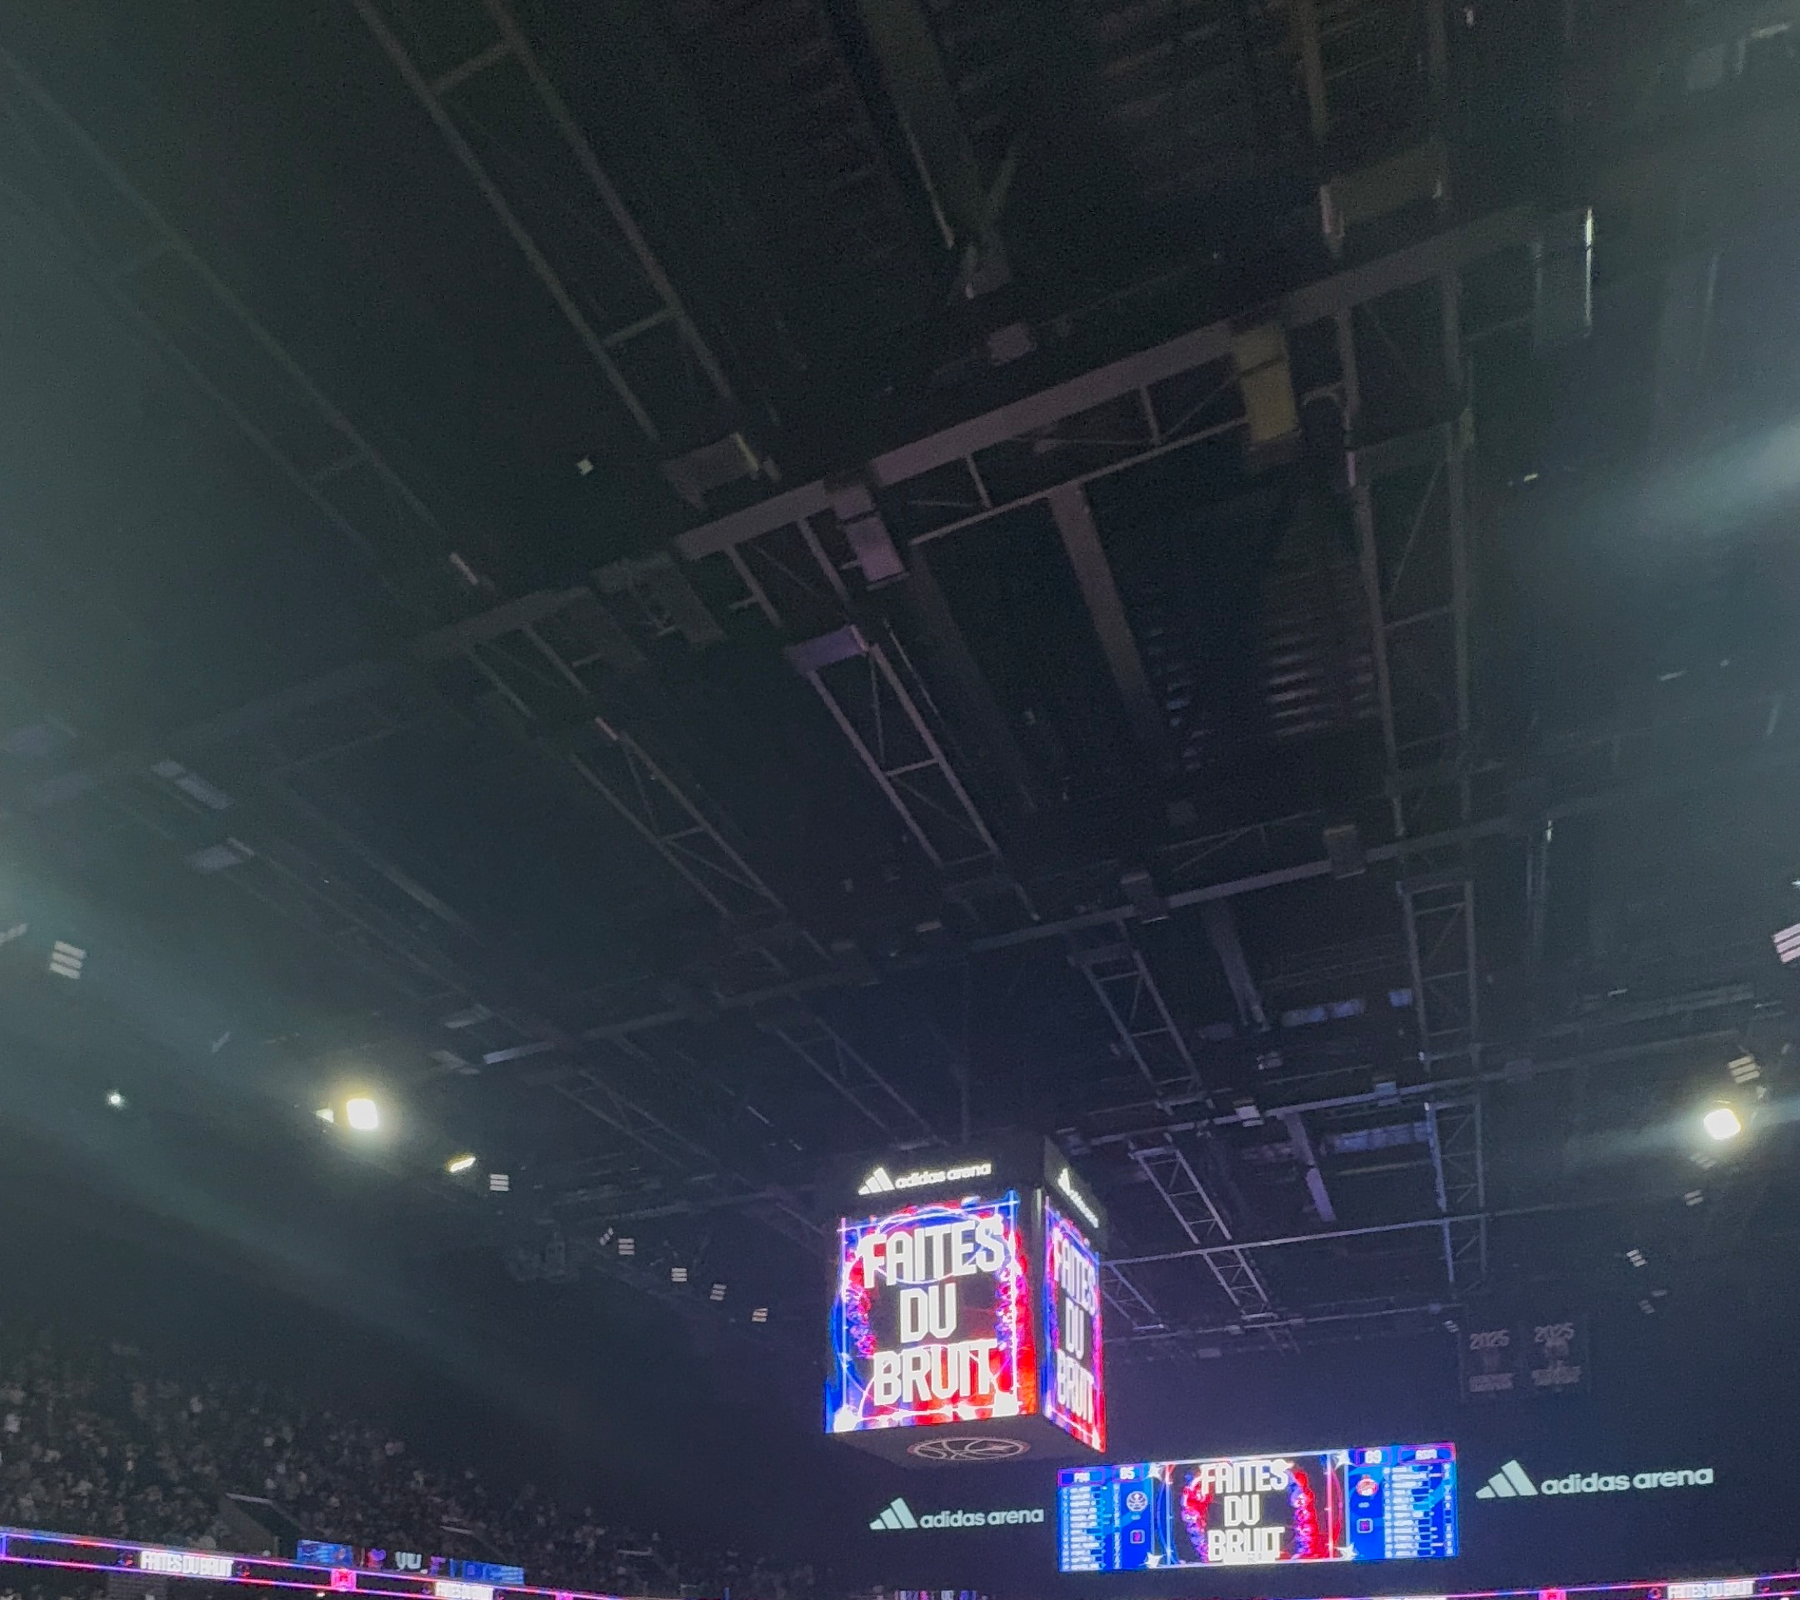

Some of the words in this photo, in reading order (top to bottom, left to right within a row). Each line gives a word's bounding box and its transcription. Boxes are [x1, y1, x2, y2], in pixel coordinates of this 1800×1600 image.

[895, 1170, 946, 1189] adidas
[947, 1163, 992, 1180] arena
[858, 1215, 1005, 1289] FAITES
[1052, 1226, 1097, 1316] FAITES
[900, 1282, 957, 1343] DU
[1065, 1297, 1085, 1360] DU
[872, 1338, 999, 1405] BRUIT
[1056, 1347, 1095, 1424] BRUIT
[1200, 1459, 1289, 1498] FAITES
[1541, 1472, 1631, 1495] adidas
[1632, 1467, 1714, 1489] arena
[920, 1509, 986, 1528] adidas
[986, 1508, 1045, 1525] arena
[1223, 1494, 1260, 1527] DU
[1207, 1526, 1285, 1562] BRUIT
